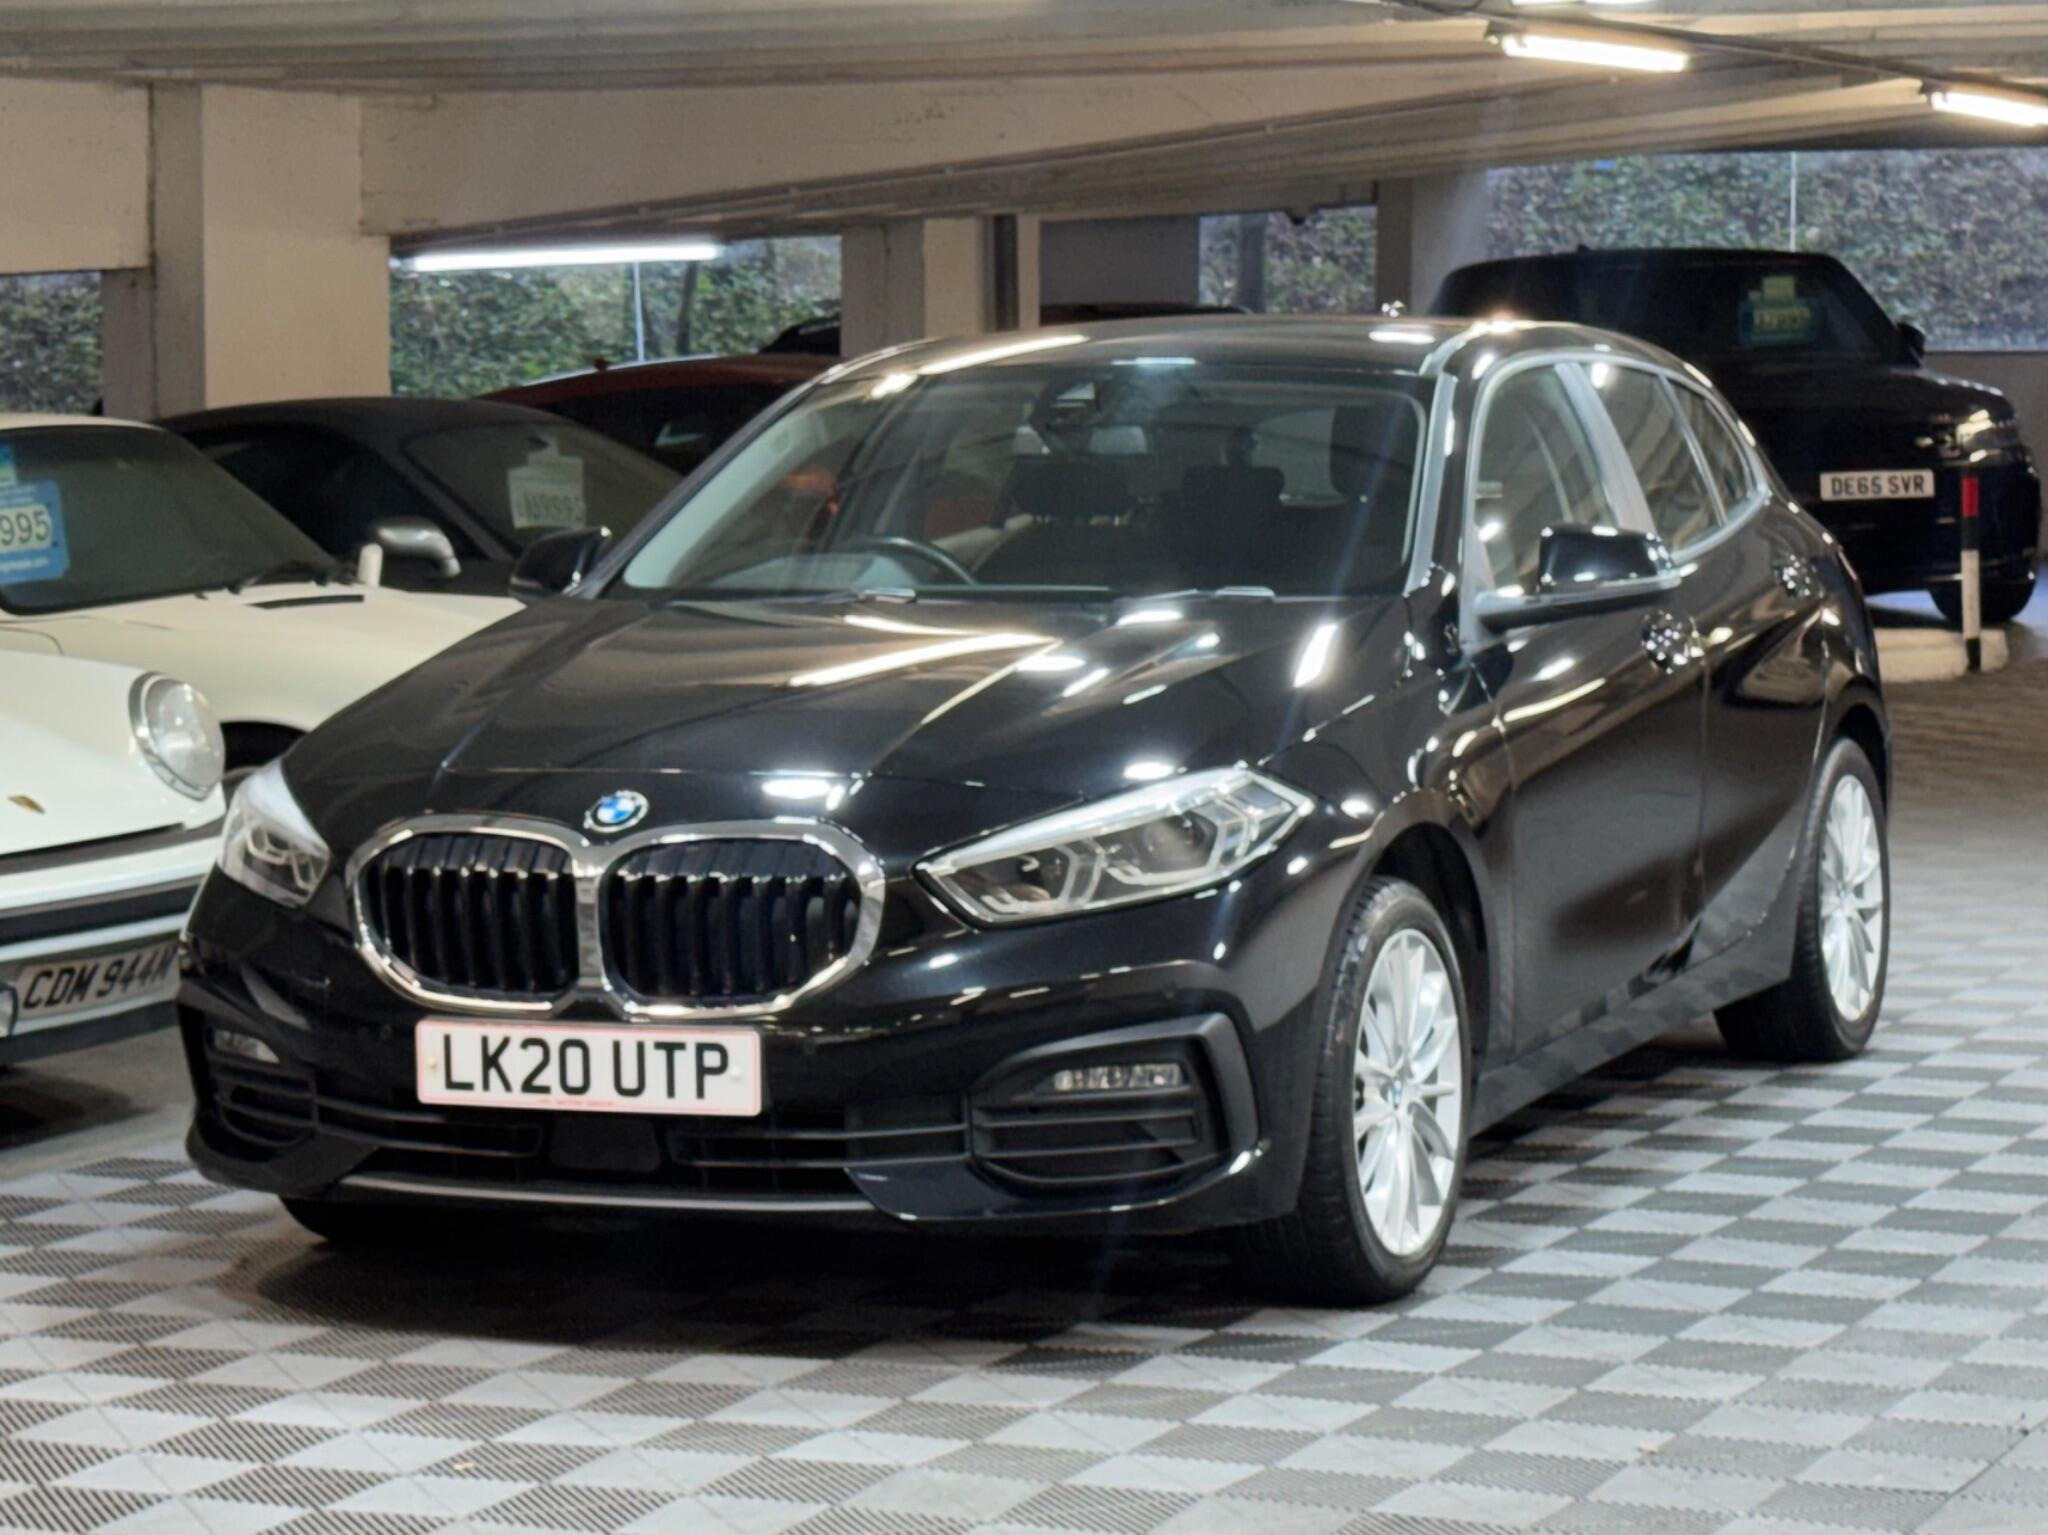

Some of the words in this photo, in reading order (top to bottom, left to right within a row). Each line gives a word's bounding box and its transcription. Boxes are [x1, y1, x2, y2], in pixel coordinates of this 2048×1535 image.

[1831, 475, 1882, 497] DE65
[1887, 474, 1925, 495] SVR
[23, 965, 99, 1009] CDM
[443, 1033, 592, 1095] LK20
[612, 1040, 729, 1099] UTP
